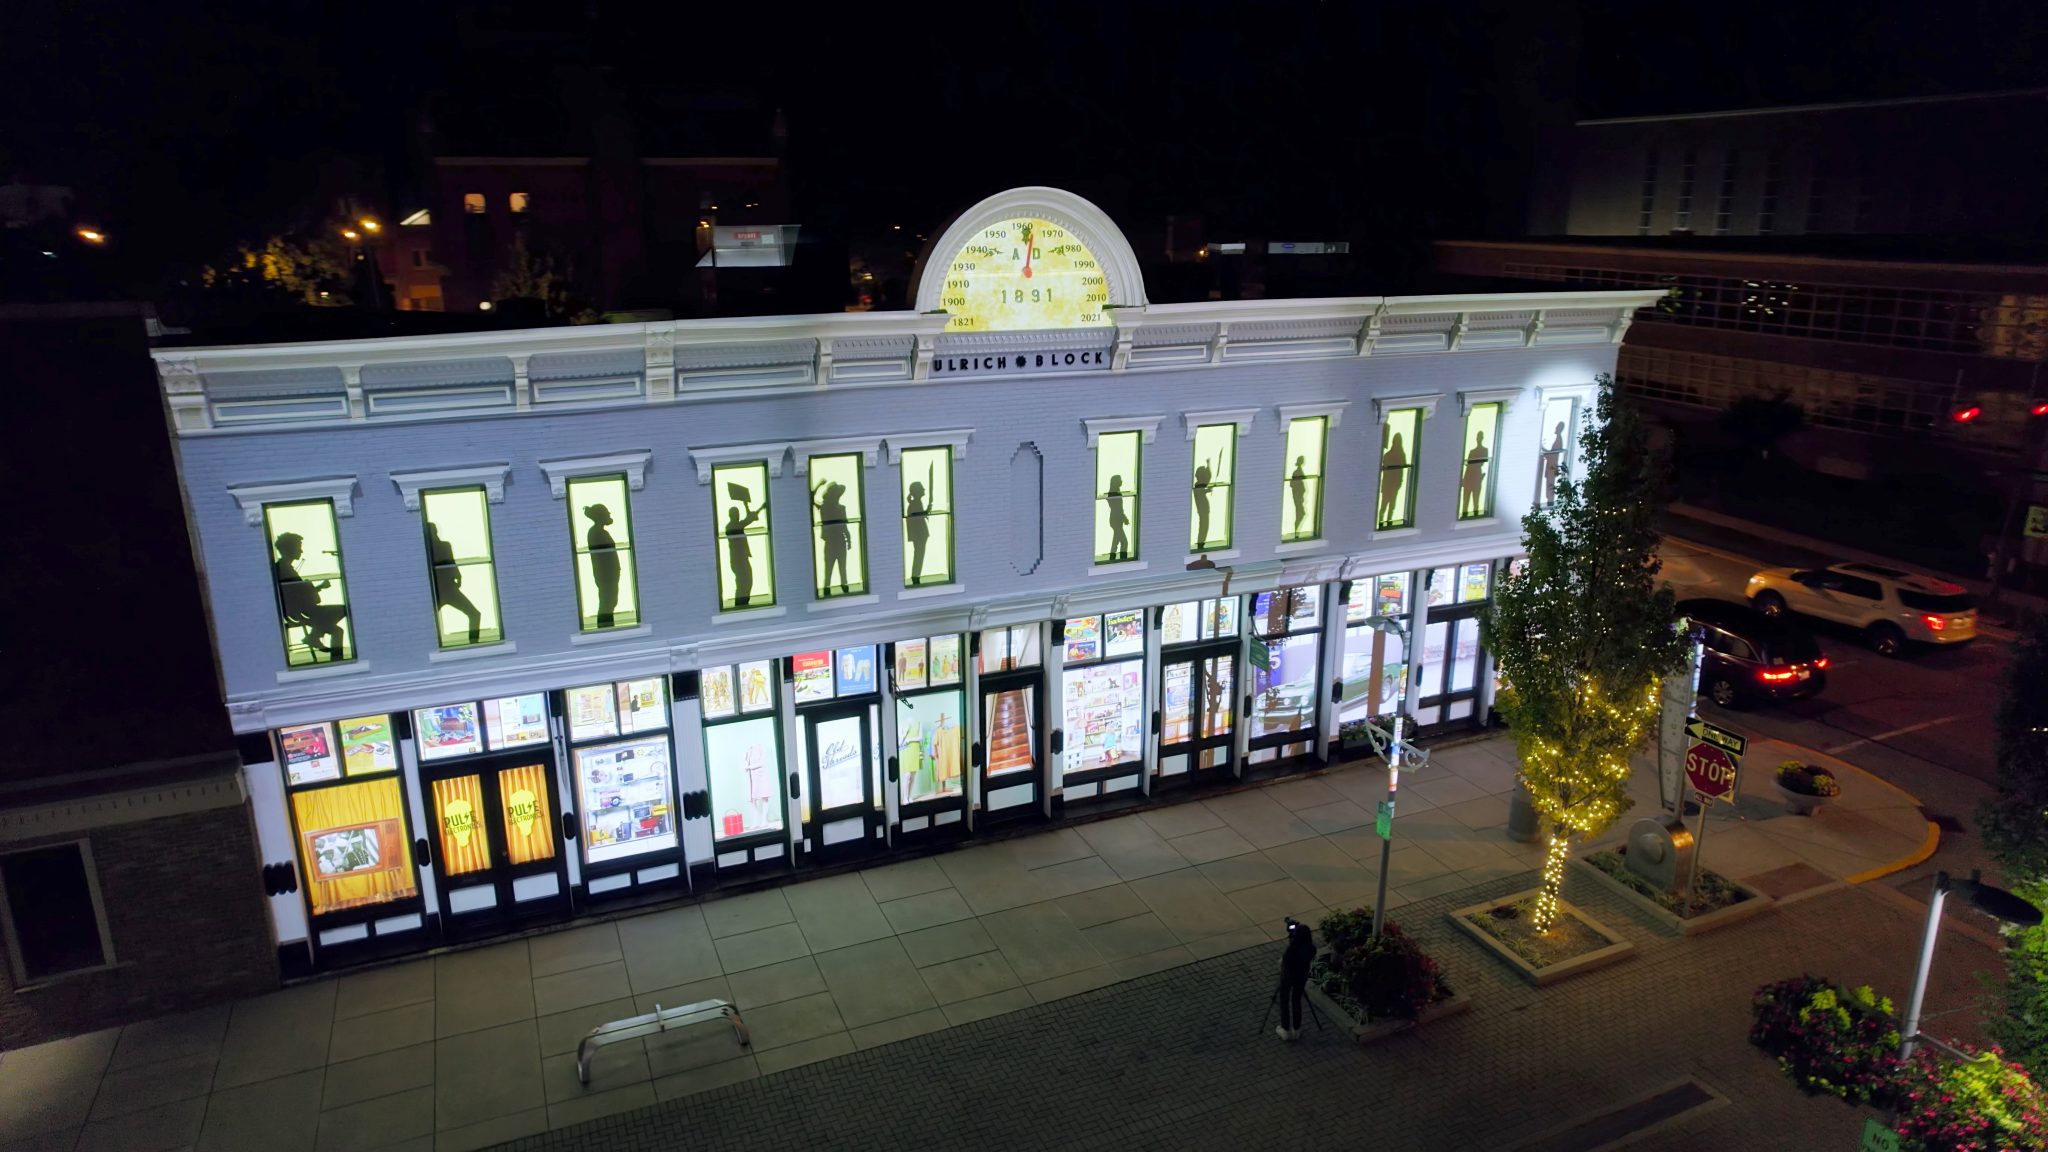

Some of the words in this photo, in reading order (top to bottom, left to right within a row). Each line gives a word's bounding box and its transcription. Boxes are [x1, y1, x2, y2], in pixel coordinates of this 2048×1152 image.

[1011, 222, 1033, 230] 1960
[984, 230, 1007, 239] 1950
[1042, 230, 1064, 238] 1970
[966, 245, 988, 254] 1940
[1060, 244, 1082, 253] 1980
[1012, 248, 1020, 261] A
[1032, 247, 1041, 260] D
[953, 262, 976, 271] 1930
[1073, 260, 1095, 269] 1990
[947, 279, 970, 289] 1910
[1082, 277, 1104, 286] 2000
[1001, 288, 1053, 304] 1891
[1086, 293, 1107, 302] 2010
[942, 297, 965, 307] 1900
[1080, 313, 1101, 322] 2021
[953, 318, 974, 327] 1821
[933, 356, 1007, 372] ULRICH
[1035, 351, 1103, 368] BLOCK
[1702, 728, 1718, 740] ONE
[1721, 735, 1739, 748] WAY
[1686, 753, 1732, 785] STOP
[1872, 1133, 1890, 1150] NO
